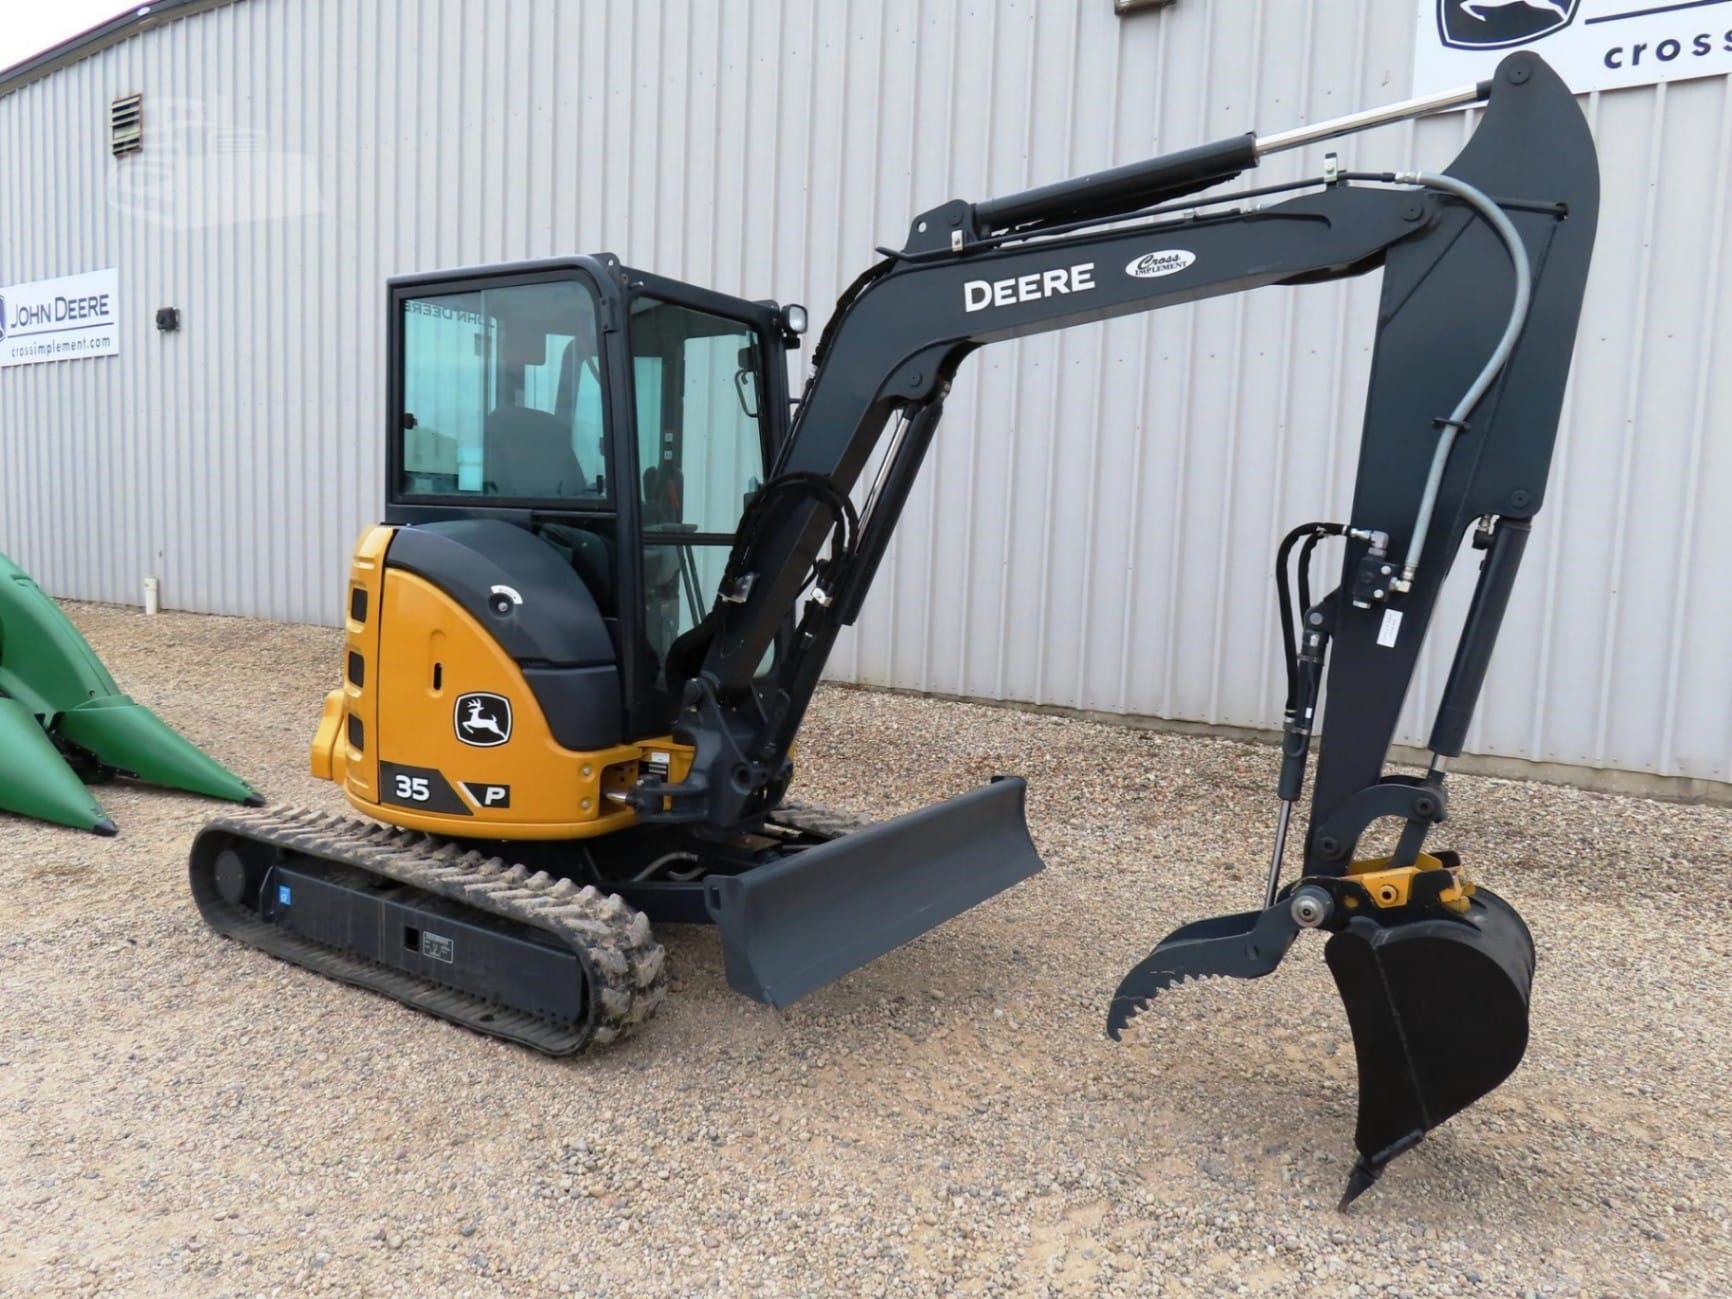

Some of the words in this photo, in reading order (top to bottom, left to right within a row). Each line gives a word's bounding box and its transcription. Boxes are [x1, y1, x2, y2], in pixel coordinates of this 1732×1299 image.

[1135, 261, 1187, 276] IMPLEMENT
[1137, 254, 1179, 270] Cross
[963, 261, 1096, 313] DEERE
[10, 303, 51, 328] JOHN
[55, 293, 110, 322] DEERE
[11, 336, 111, 358] crossimplement.com
[395, 774, 430, 801] 35
[484, 786, 506, 805] P
